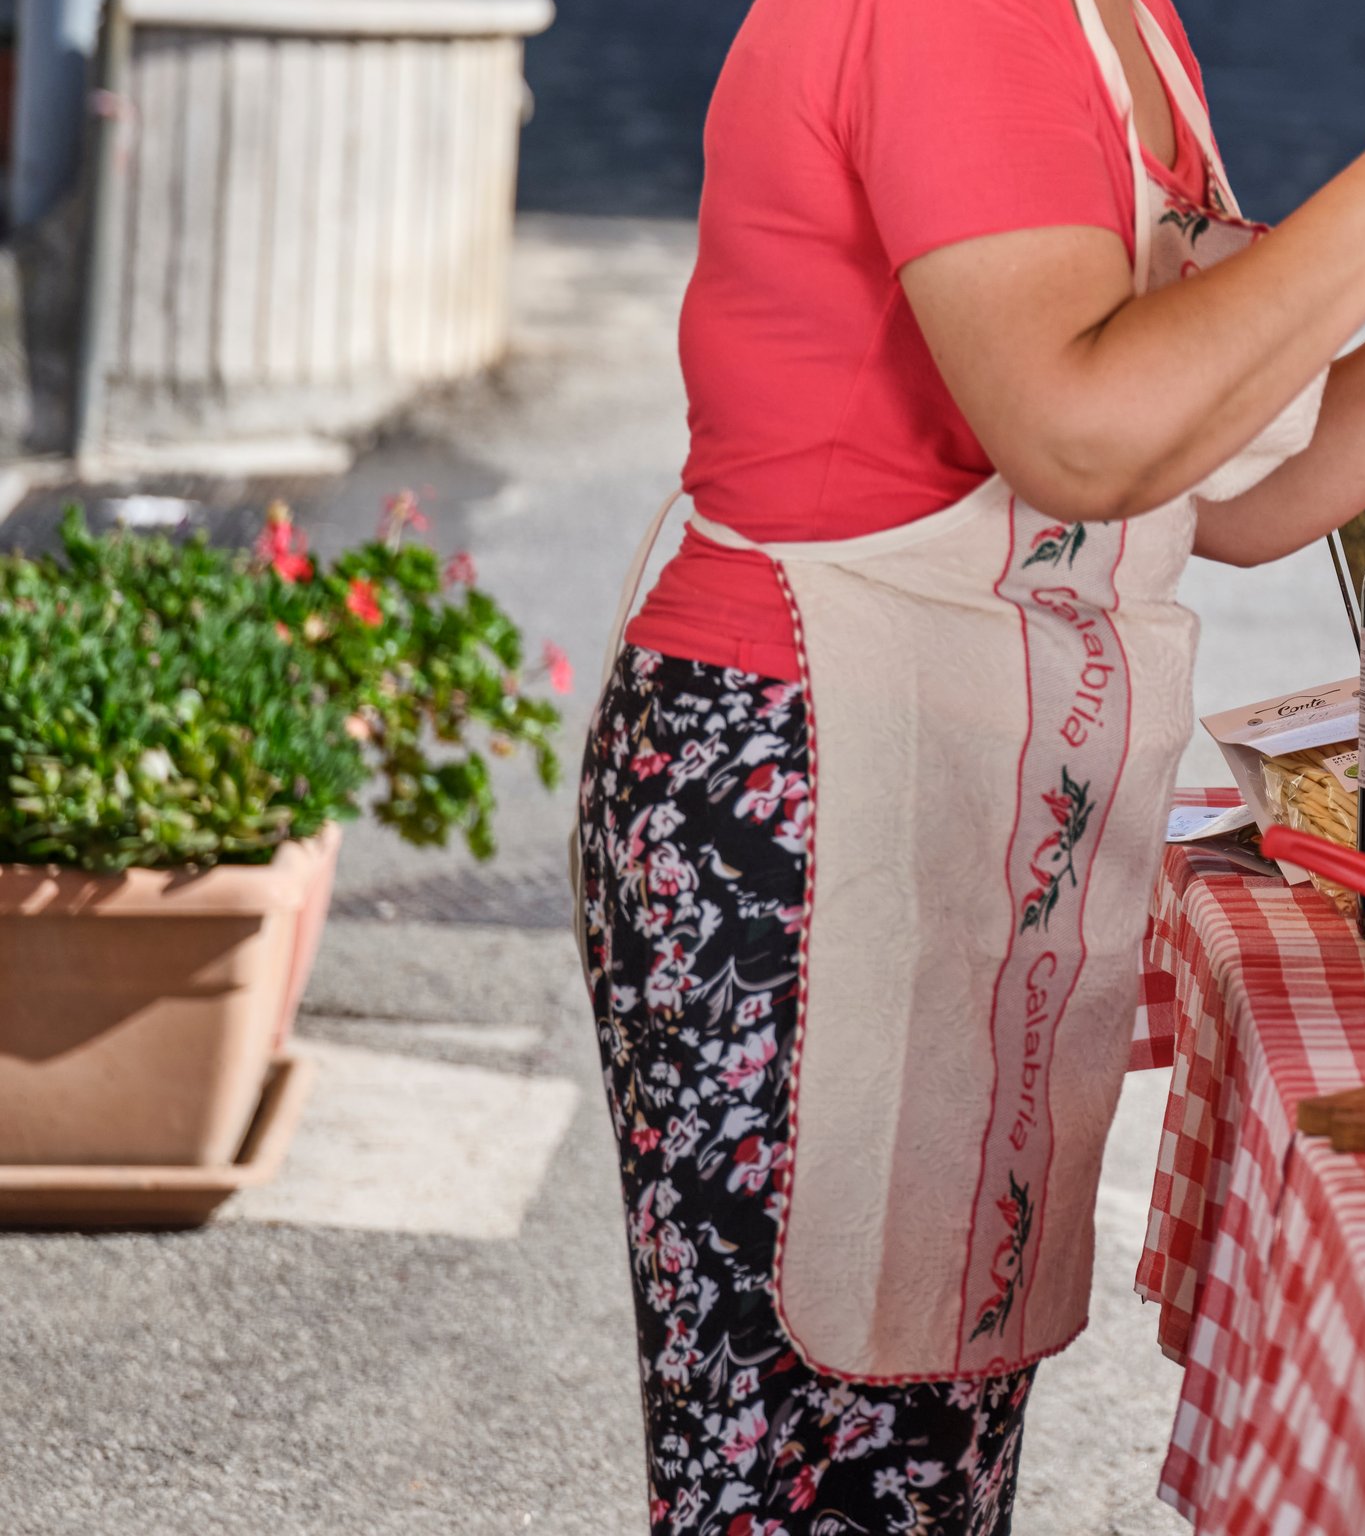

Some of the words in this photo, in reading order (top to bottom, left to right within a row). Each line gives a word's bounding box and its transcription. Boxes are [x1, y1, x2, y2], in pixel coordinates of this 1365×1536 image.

[1031, 586, 1115, 748] Calabria
[1277, 698, 1327, 717] Conte
[1008, 950, 1058, 1153] Calabria
